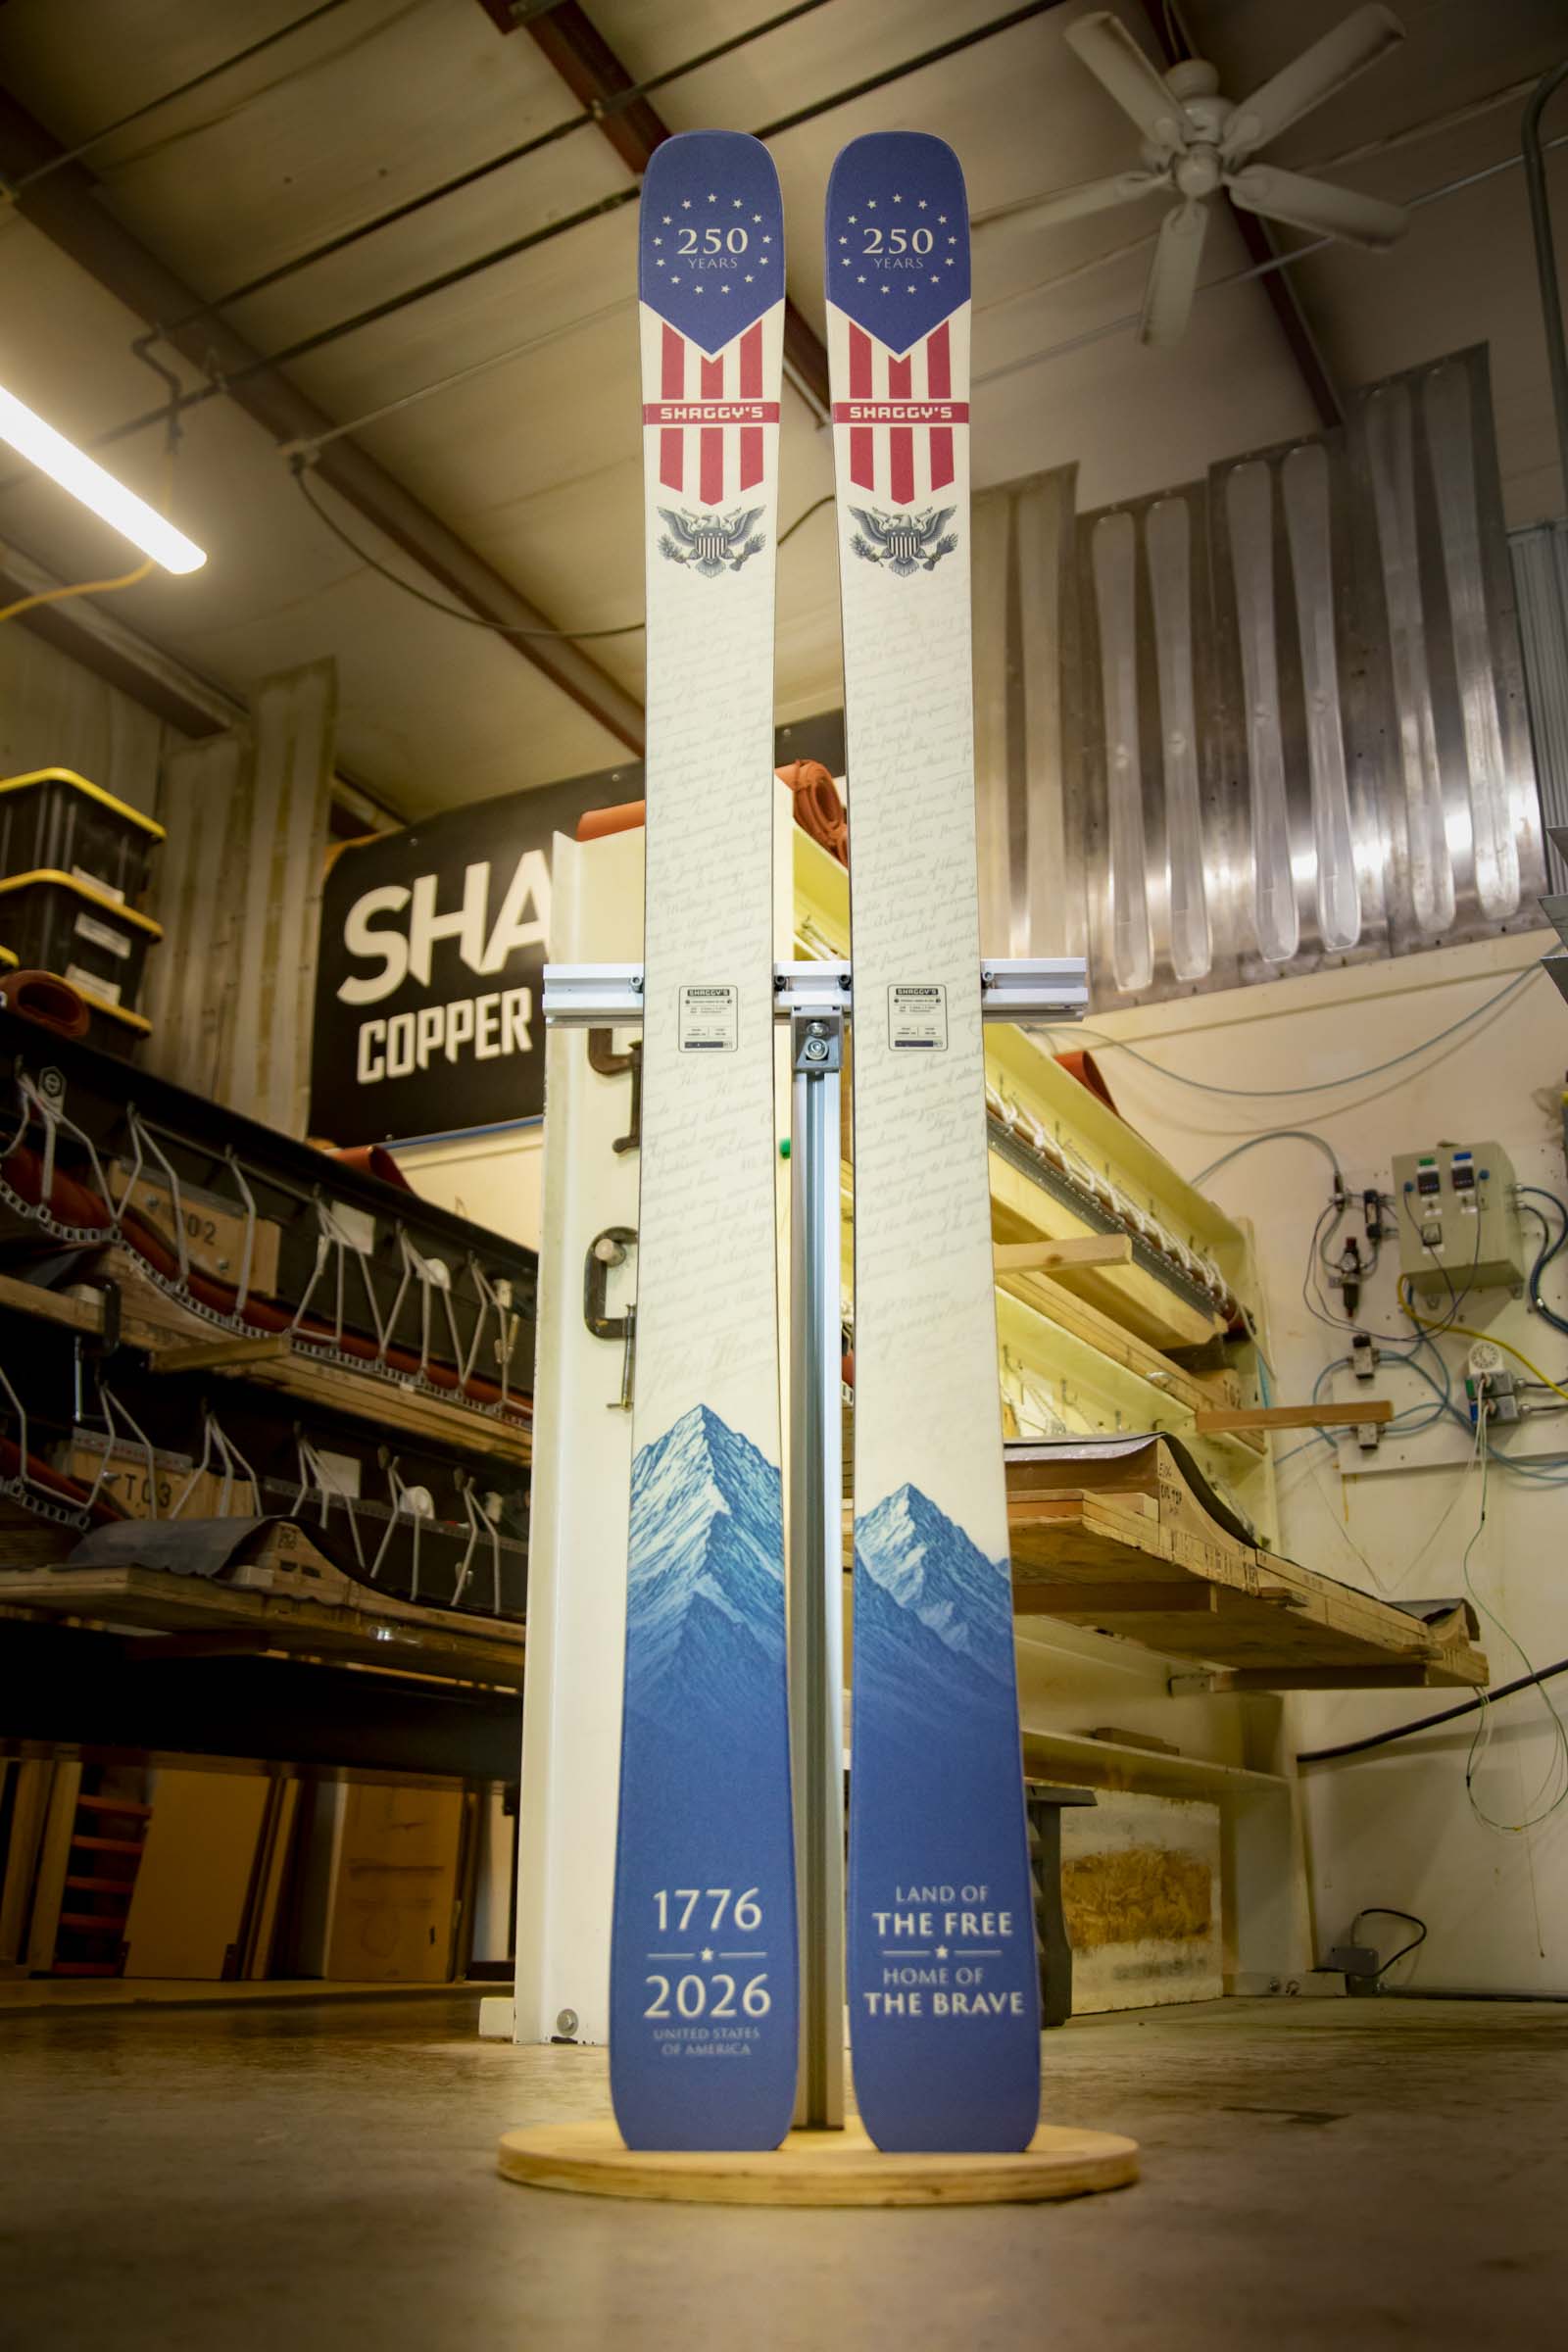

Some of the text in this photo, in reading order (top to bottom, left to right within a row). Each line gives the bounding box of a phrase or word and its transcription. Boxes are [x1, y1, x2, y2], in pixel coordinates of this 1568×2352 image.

[677, 227, 749, 255] 250
[862, 227, 934, 255] 250
[687, 257, 738, 270] YEARS
[873, 257, 924, 270] YEARS
[660, 406, 763, 419] SHAGGY'S
[850, 406, 953, 419] SHAGGY'S
[357, 987, 533, 1084] COPPER
[896, 1885, 988, 1903] LAND OF
[654, 1886, 762, 1932] 1776
[872, 1912, 1013, 1936] THE FREE
[883, 1967, 984, 1985] HOME OF
[644, 1973, 771, 2019] 2026
[863, 1991, 1024, 2015] THE BRAVE
[654, 2027, 760, 2040] UNITED STATES
[662, 2042, 752, 2056] OF AMERICA
